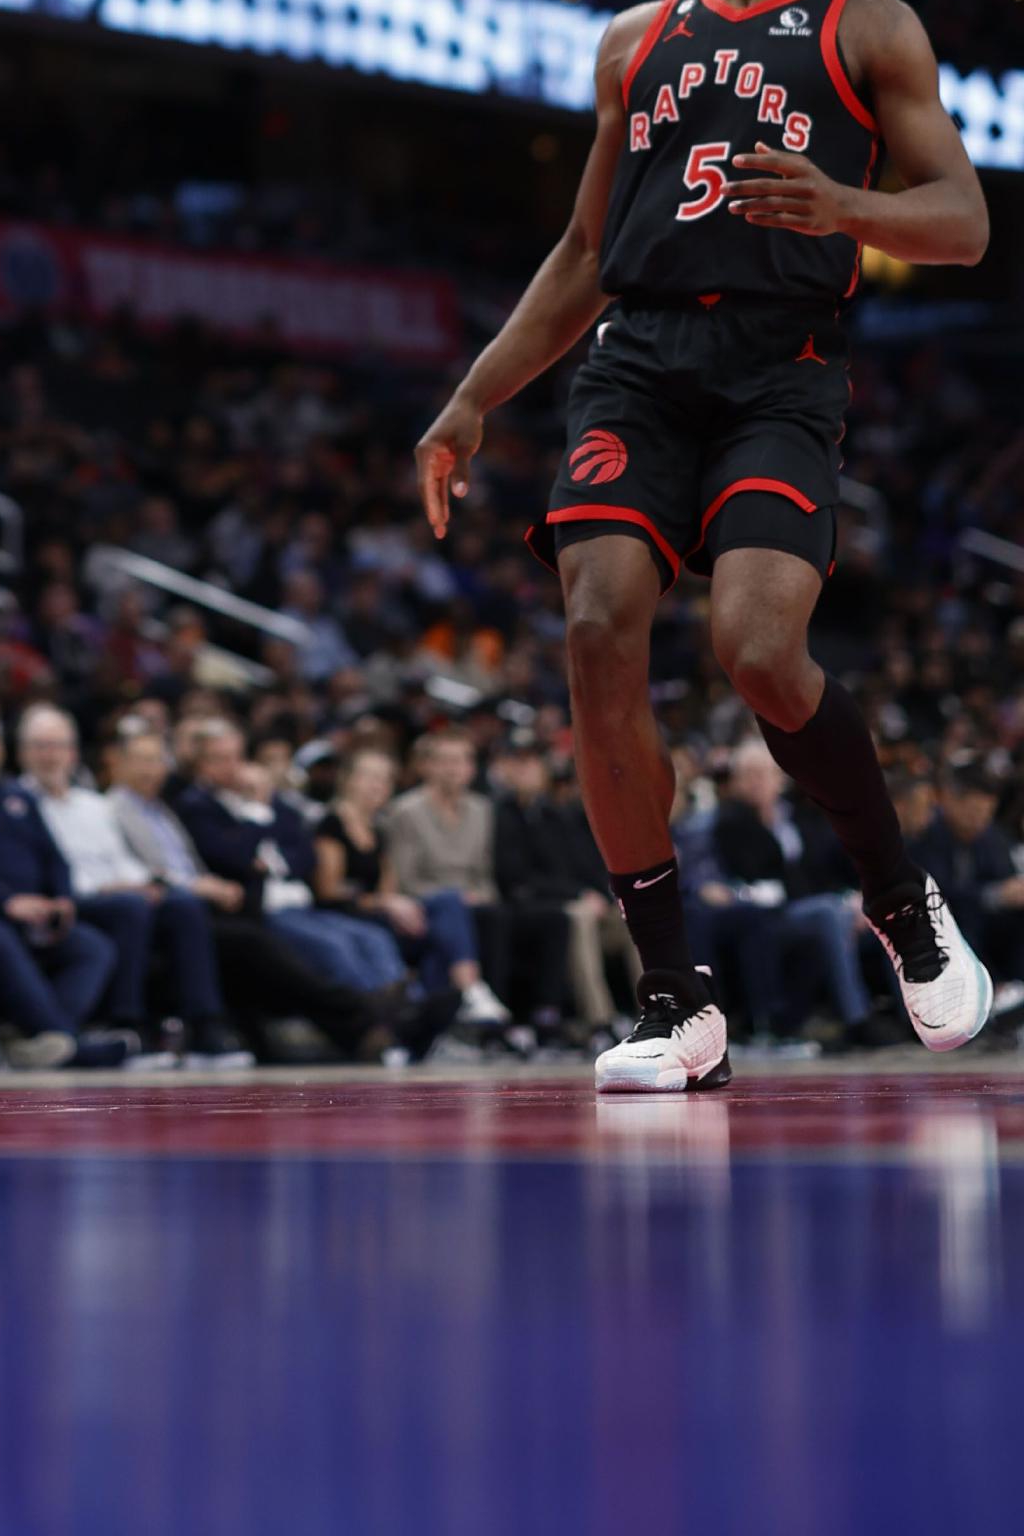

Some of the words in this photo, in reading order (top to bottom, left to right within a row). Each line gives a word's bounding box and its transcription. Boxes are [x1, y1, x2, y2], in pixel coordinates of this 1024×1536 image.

[768, 26, 790, 37] Sun
[791, 26, 813, 37] Life
[630, 49, 812, 152] RAPTORS
[675, 141, 731, 222] 5
